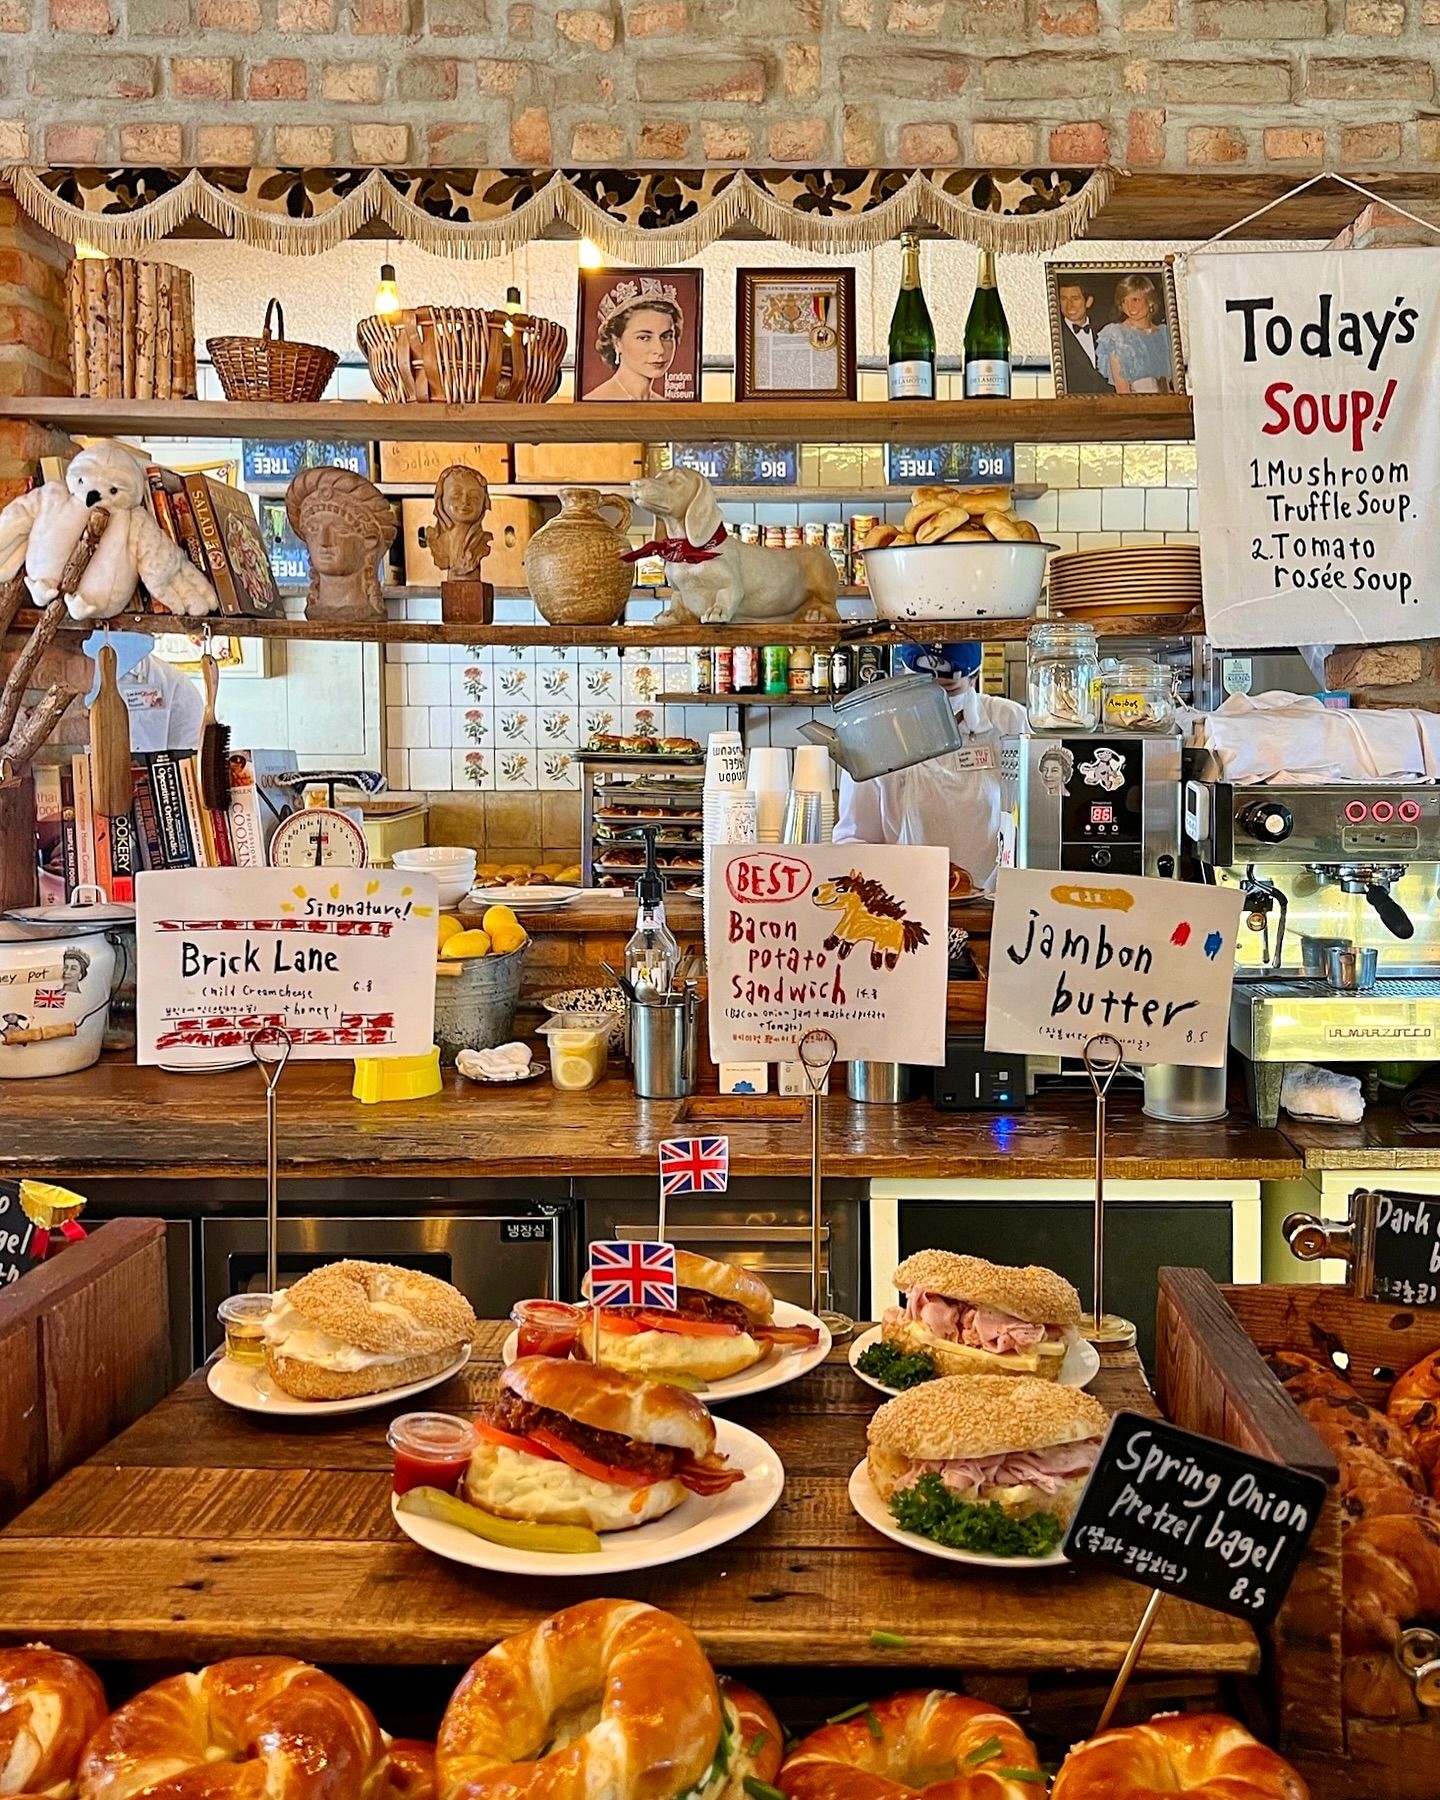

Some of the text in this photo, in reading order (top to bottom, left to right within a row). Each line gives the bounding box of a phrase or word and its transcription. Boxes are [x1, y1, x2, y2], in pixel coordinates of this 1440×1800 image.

[1226, 294, 1419, 371] Today's
[665, 371, 693, 381] London
[665, 381, 686, 391] Bagel
[665, 390, 694, 399] Museum
[254, 457, 291, 475] TREE
[682, 461, 787, 478] BIG TRE
[899, 459, 1004, 476] BIG TREE
[191, 490, 215, 537] SALAD
[1266, 490, 1351, 522] Truffle
[271, 560, 306, 577] TREE
[1274, 562, 1348, 589] rosée
[712, 746, 742, 757] useum
[722, 757, 745, 770] AGEL
[718, 770, 747, 784] ondon
[38, 803, 61, 815] ood
[1092, 808, 1110, 821] 86
[115, 815, 131, 872] OOKERY
[232, 802, 252, 868] COOKIN
[246, 813, 258, 868] PROFESSIONA
[737, 861, 800, 897] BEST
[304, 897, 412, 921] Singnature!
[728, 910, 797, 944] Bacon
[1007, 909, 1153, 974] jambon
[182, 939, 340, 978] Brick Lane
[749, 948, 827, 974] potato
[0, 968, 49, 985] ey pot
[1051, 970, 1200, 1027] butter
[1185, 1030, 1209, 1043] 8.5
[1348, 1029, 1431, 1037] MARZOCCO
[1376, 1196, 1431, 1236] Dark
[507, 1224, 545, 1237] 냉장실
[1116, 1431, 1308, 1532] Spring Onion
[1205, 1510, 1286, 1574] bagel
[1229, 1577, 1266, 1609] 8.5
